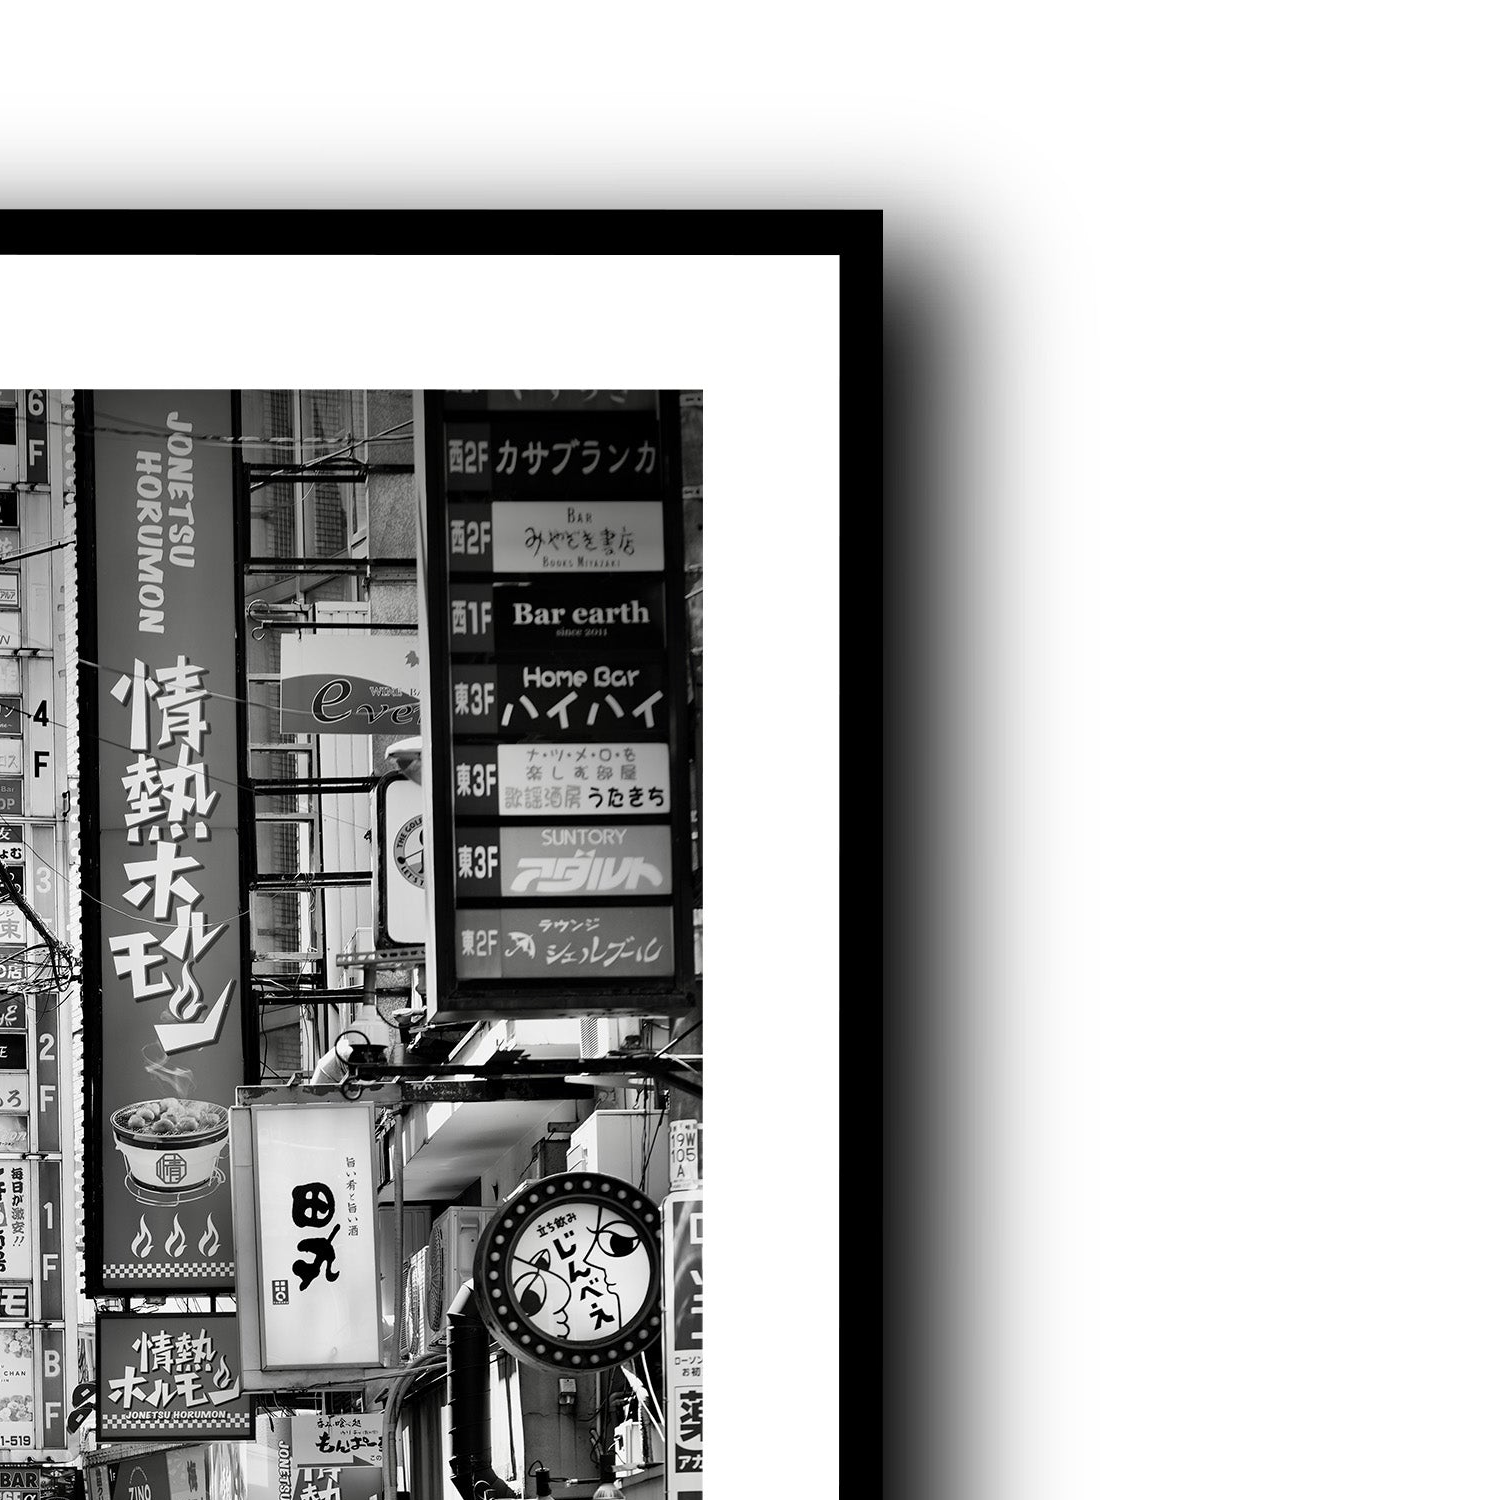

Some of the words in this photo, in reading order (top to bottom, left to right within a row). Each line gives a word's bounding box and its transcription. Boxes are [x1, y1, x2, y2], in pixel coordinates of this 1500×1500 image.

[495, 439, 656, 475] カサブランカ
[166, 411, 195, 568] JONETSU
[136, 450, 165, 634] HORUMON
[512, 602, 566, 625] Bar
[572, 600, 650, 624] earth
[523, 666, 588, 688] Home
[594, 665, 640, 688] Bar
[454, 682, 495, 716] 東3F
[501, 690, 664, 729] ハイハイ
[456, 763, 497, 798] 東3F
[589, 786, 665, 808] うたきち
[541, 829, 627, 846] SUNTORY
[458, 845, 498, 879] 東3F
[461, 929, 498, 957] 東2F
[671, 1149, 696, 1162] 105
[676, 1164, 686, 1178] A
[536, 1212, 577, 1238] 立ち飲み
[552, 1230, 616, 1331] じんべえ
[131, 1328, 218, 1373] 情熱
[108, 1365, 240, 1409] ホルモン
[125, 1410, 171, 1420] JONETSU
[173, 1410, 227, 1419] HORUMON
[0, 1471, 39, 1488] BAR
